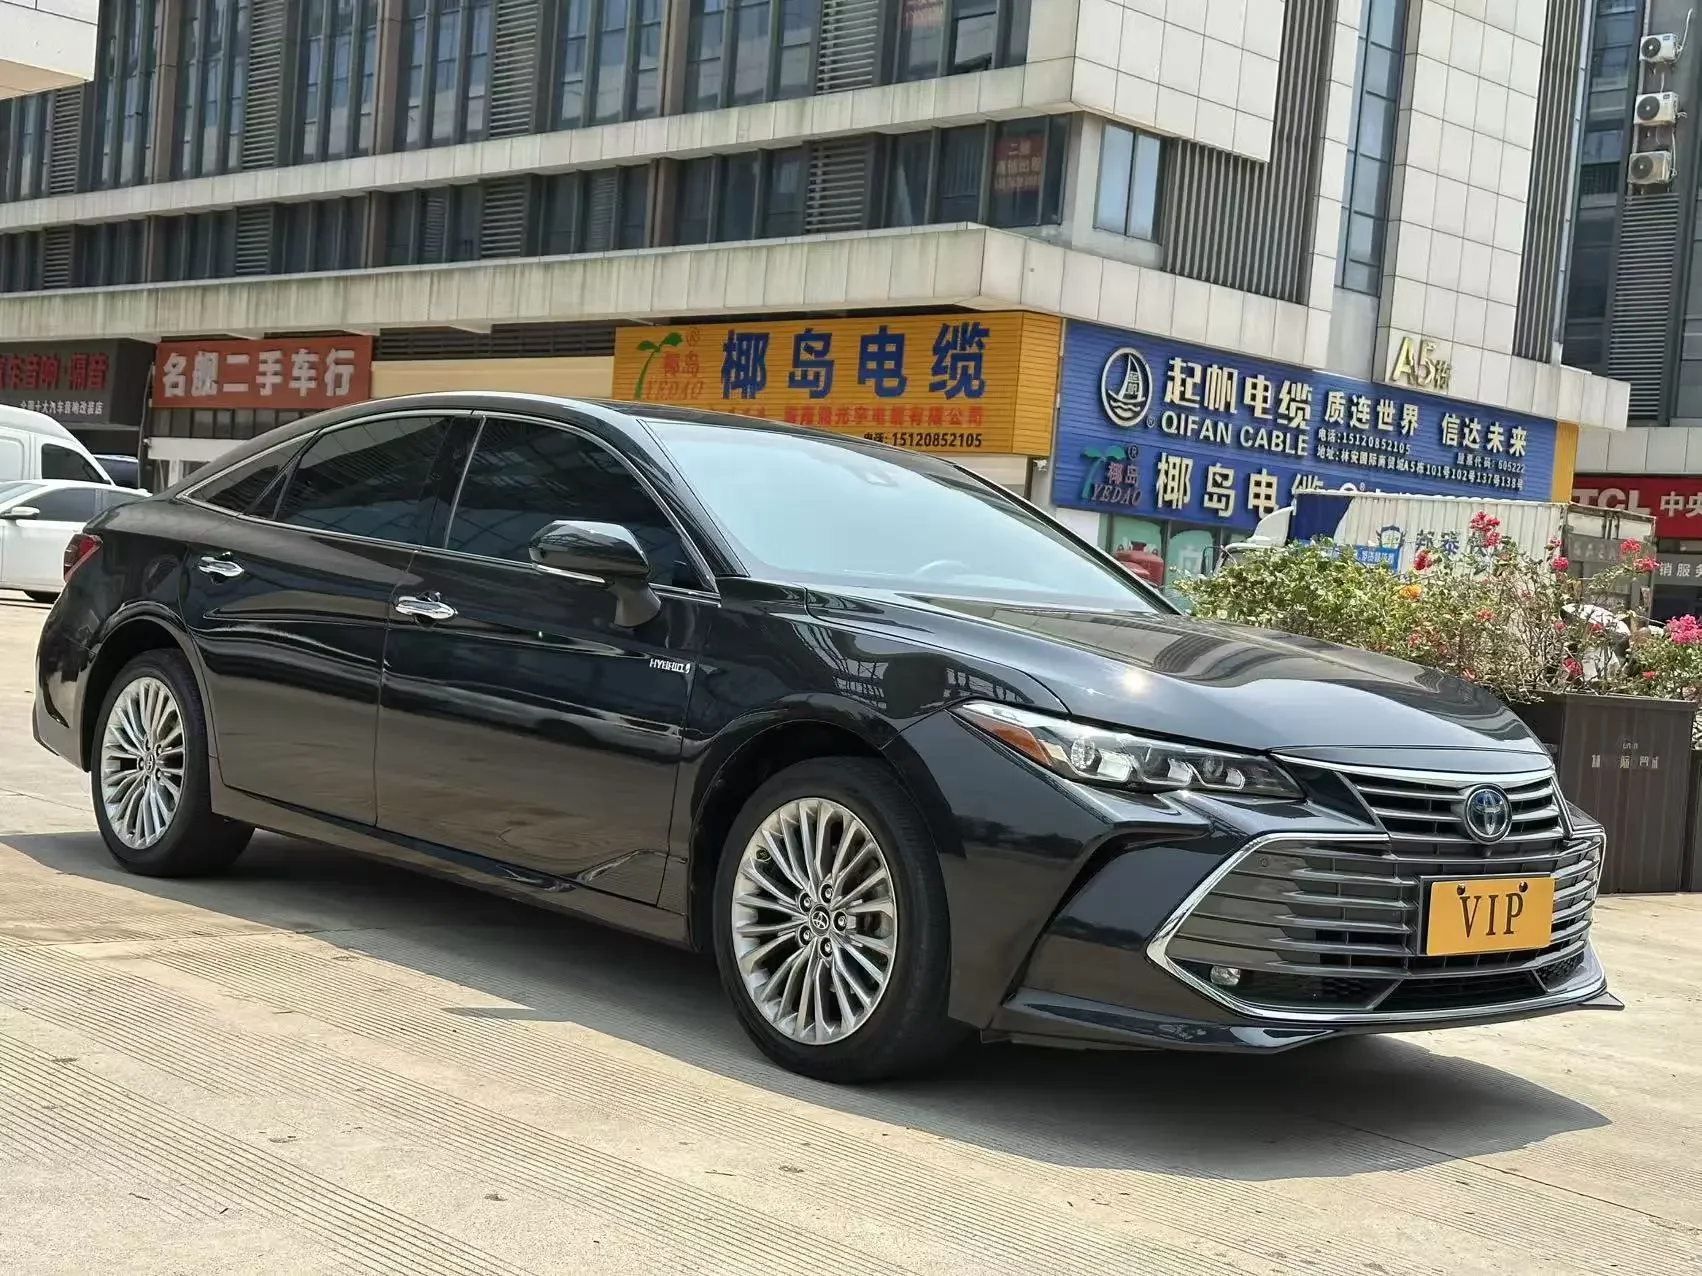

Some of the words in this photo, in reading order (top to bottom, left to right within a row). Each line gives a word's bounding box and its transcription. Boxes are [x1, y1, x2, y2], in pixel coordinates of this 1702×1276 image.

[720, 321, 991, 400] 椰岛电缆
[1163, 357, 1312, 430] 起帆电缆
[892, 432, 983, 448] 15120852105
[1161, 411, 1232, 444] QIFAN
[1240, 426, 1309, 456] CABLE
[1324, 391, 1420, 436] 质连世界
[1441, 412, 1528, 457] 信达未来
[1091, 483, 1143, 505] YEDAO
[1459, 893, 1524, 938] VIP
